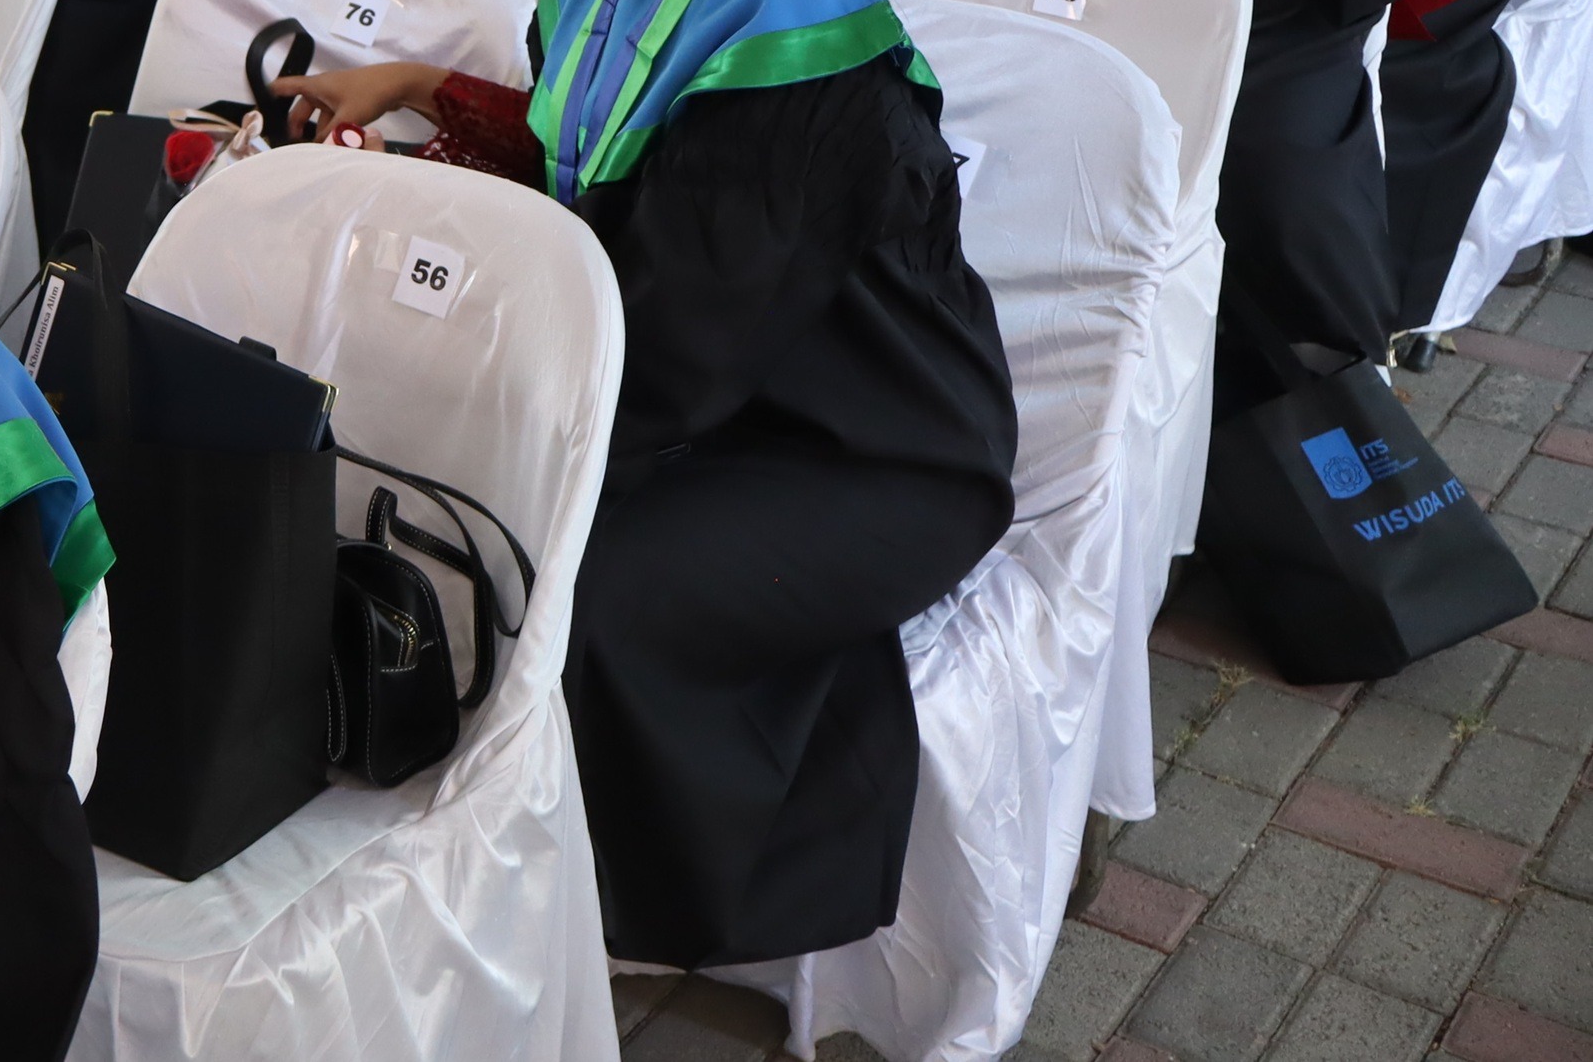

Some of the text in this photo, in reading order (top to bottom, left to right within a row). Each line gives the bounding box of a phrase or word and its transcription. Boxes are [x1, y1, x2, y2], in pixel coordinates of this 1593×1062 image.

[345, 2, 376, 27] 76
[411, 258, 449, 291] 56
[29, 286, 59, 368] Khoirunisa Alim
[1360, 438, 1389, 459] ITS
[1353, 490, 1445, 541] WISUDA
